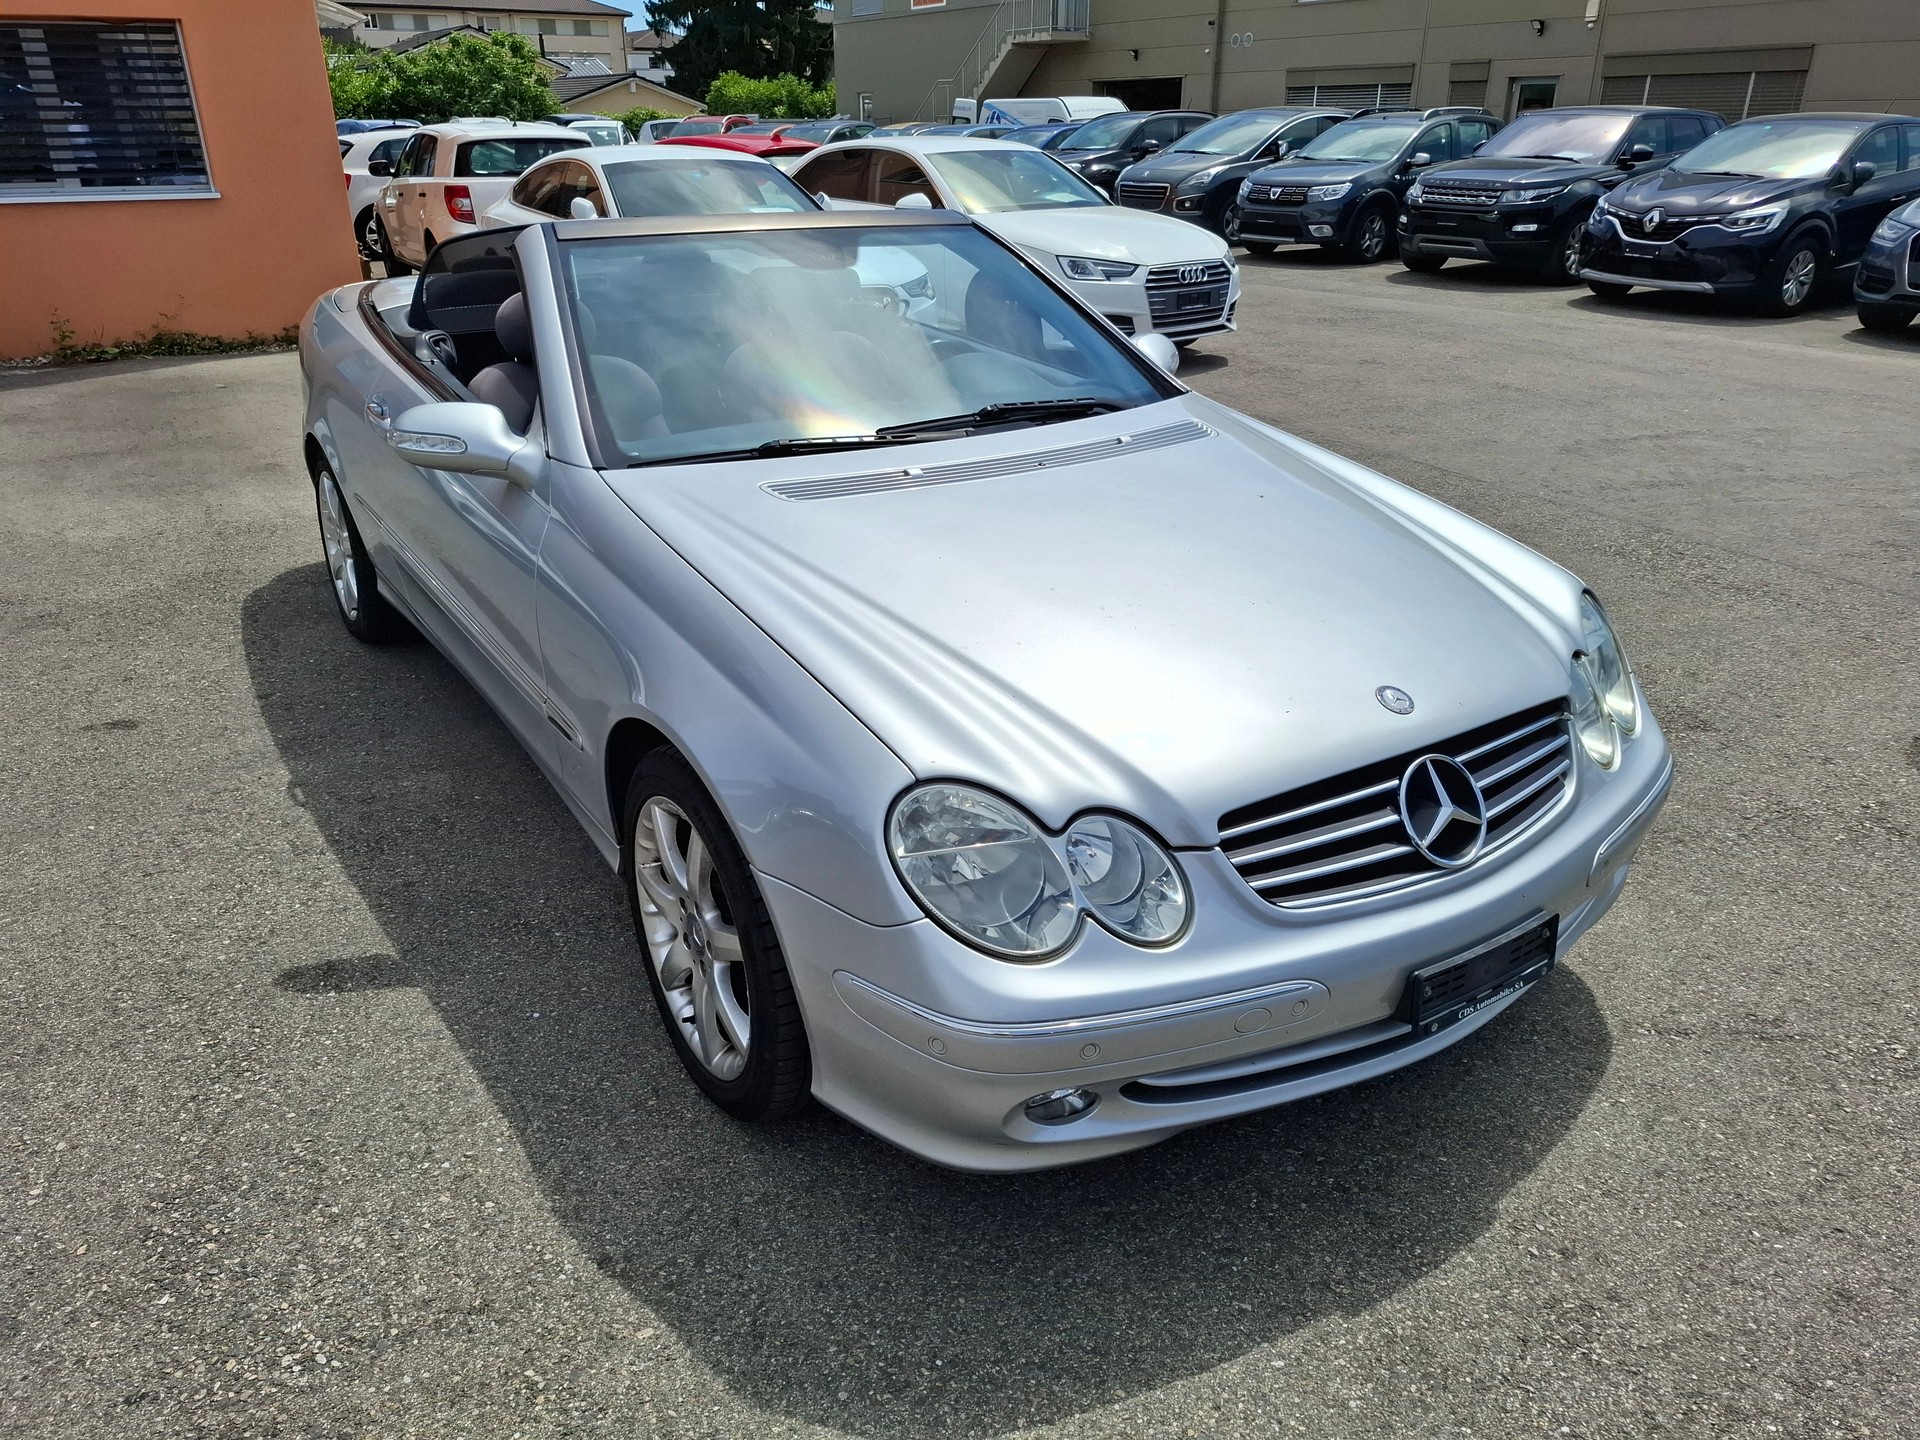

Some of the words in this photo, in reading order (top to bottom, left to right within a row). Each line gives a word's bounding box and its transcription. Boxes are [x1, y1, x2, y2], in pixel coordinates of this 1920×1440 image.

[1458, 1005, 1475, 1019] CDS
[1475, 987, 1514, 1012] Automobiles
[1514, 980, 1524, 991] SA
